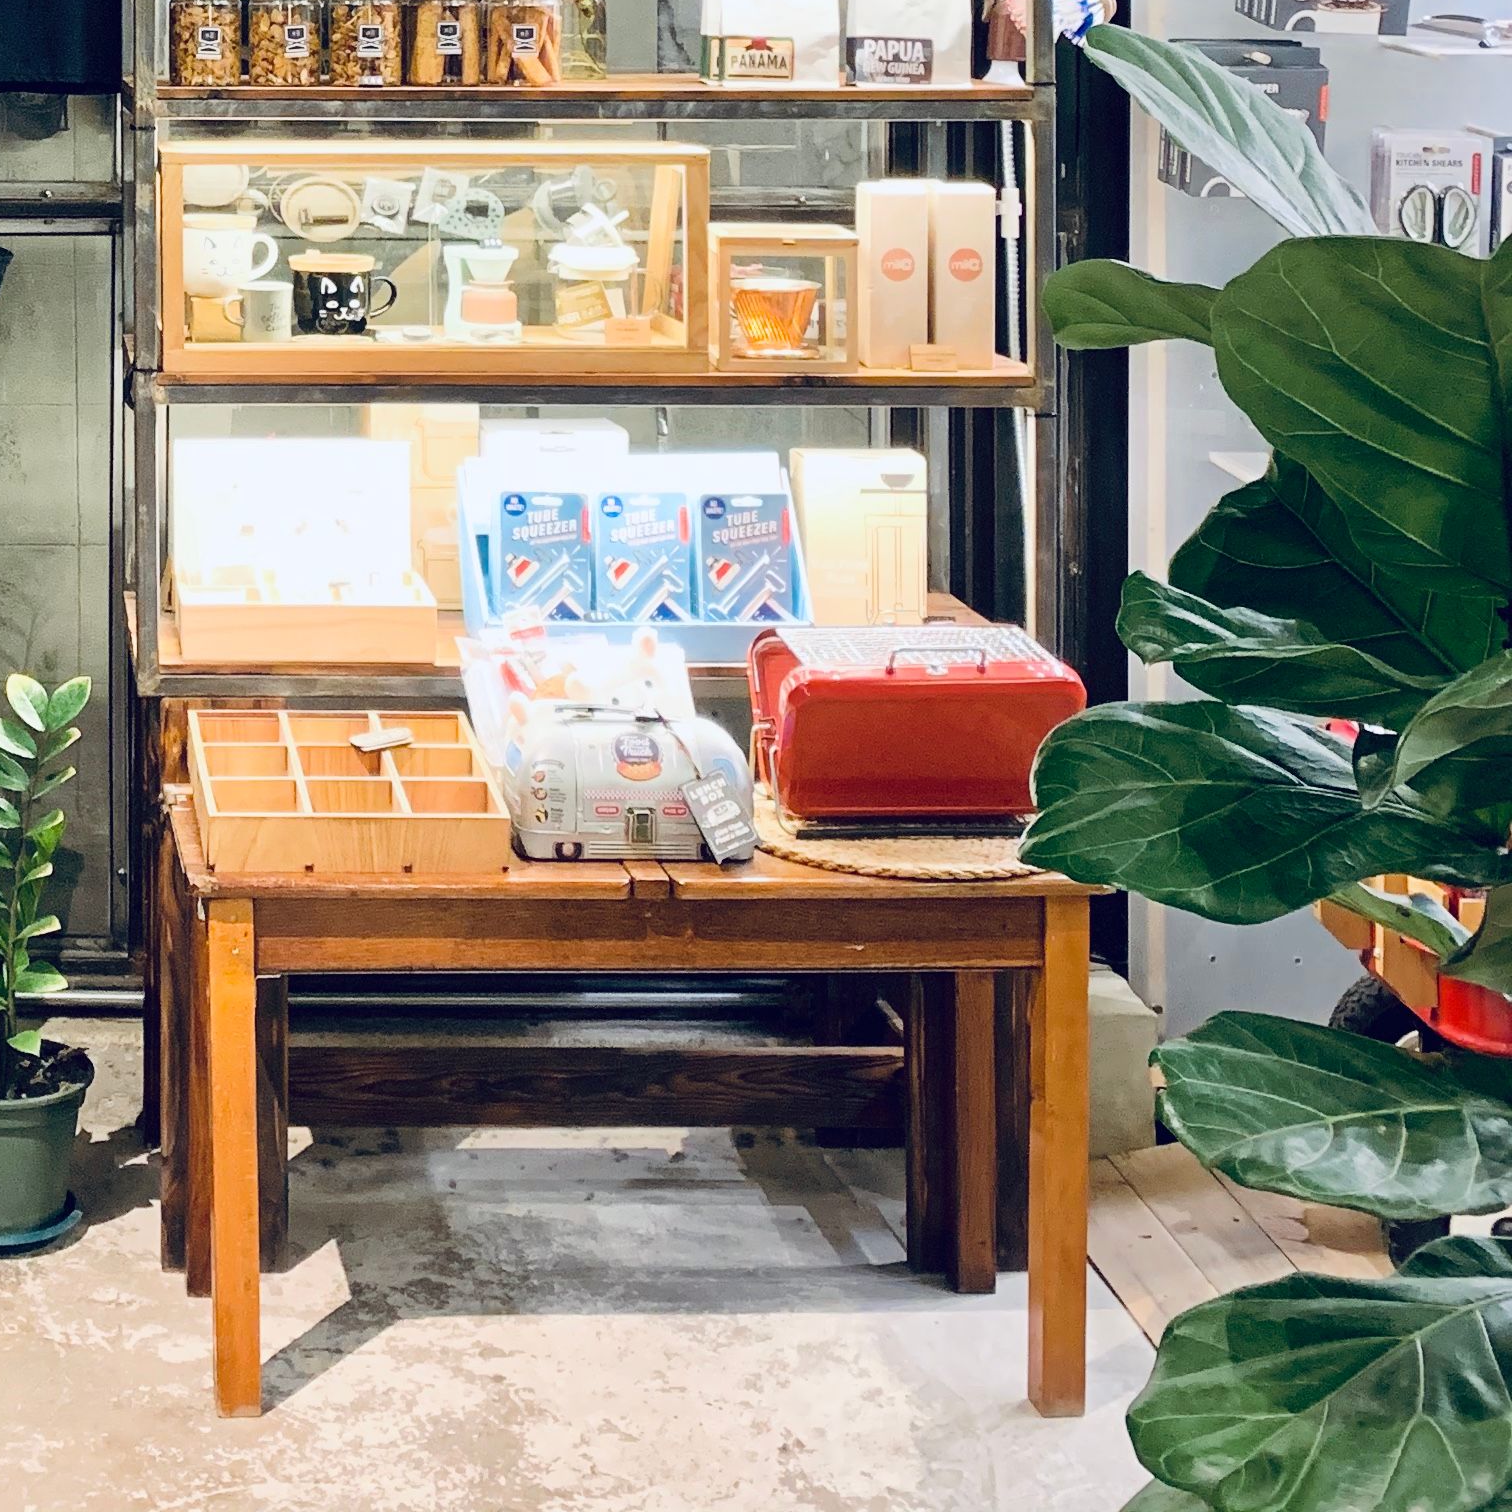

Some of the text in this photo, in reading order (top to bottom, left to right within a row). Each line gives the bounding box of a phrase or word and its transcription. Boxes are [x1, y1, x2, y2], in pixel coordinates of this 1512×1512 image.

[863, 39, 928, 62] PAPUA
[730, 52, 787, 70] PANAMA
[887, 61, 925, 76] GUINEA
[1432, 159, 1463, 167] SHEARS
[527, 508, 559, 524] TUBE
[624, 508, 656, 526] TUBE
[726, 510, 758, 527] TUBE
[512, 519, 577, 541] SQUEEZER
[610, 519, 675, 543] SQUEEZER
[712, 520, 777, 545] SQUEEZER
[689, 778, 727, 801] LUNCH
[700, 789, 725, 806] BOX
